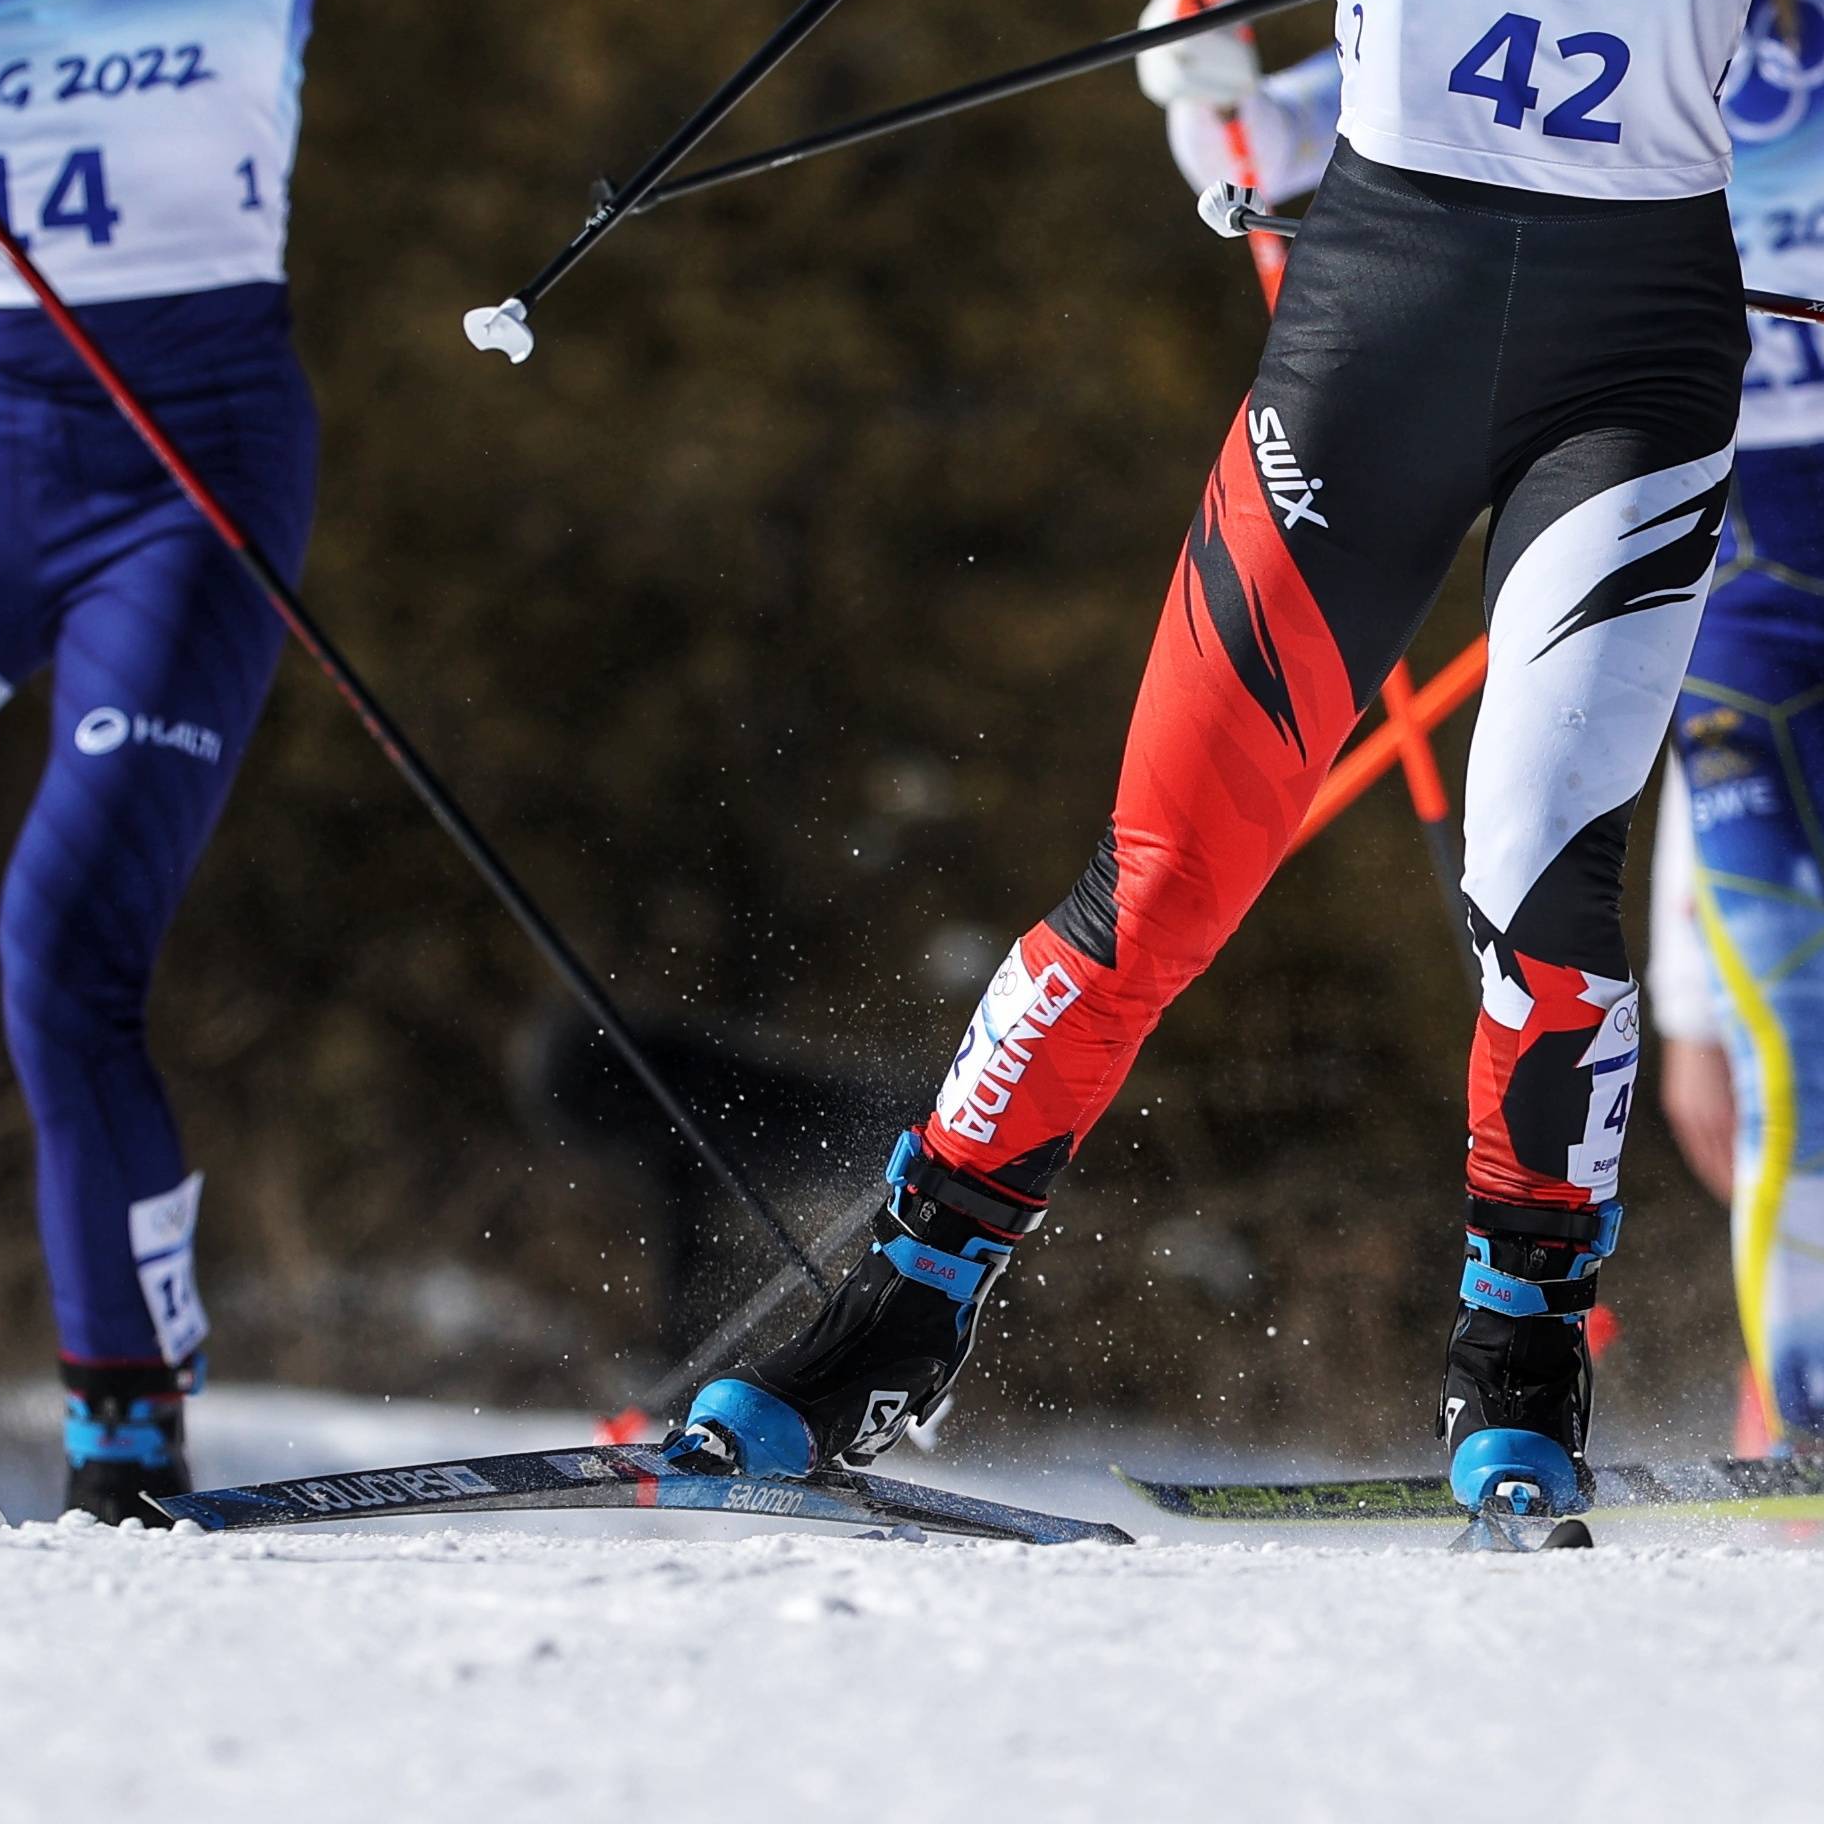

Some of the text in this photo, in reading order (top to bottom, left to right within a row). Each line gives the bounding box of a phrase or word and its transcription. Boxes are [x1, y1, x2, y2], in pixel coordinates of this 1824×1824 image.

[56, 43, 219, 104] 2022
[1448, 12, 1631, 145] 42
[952, 961, 1083, 1144] CANADA
